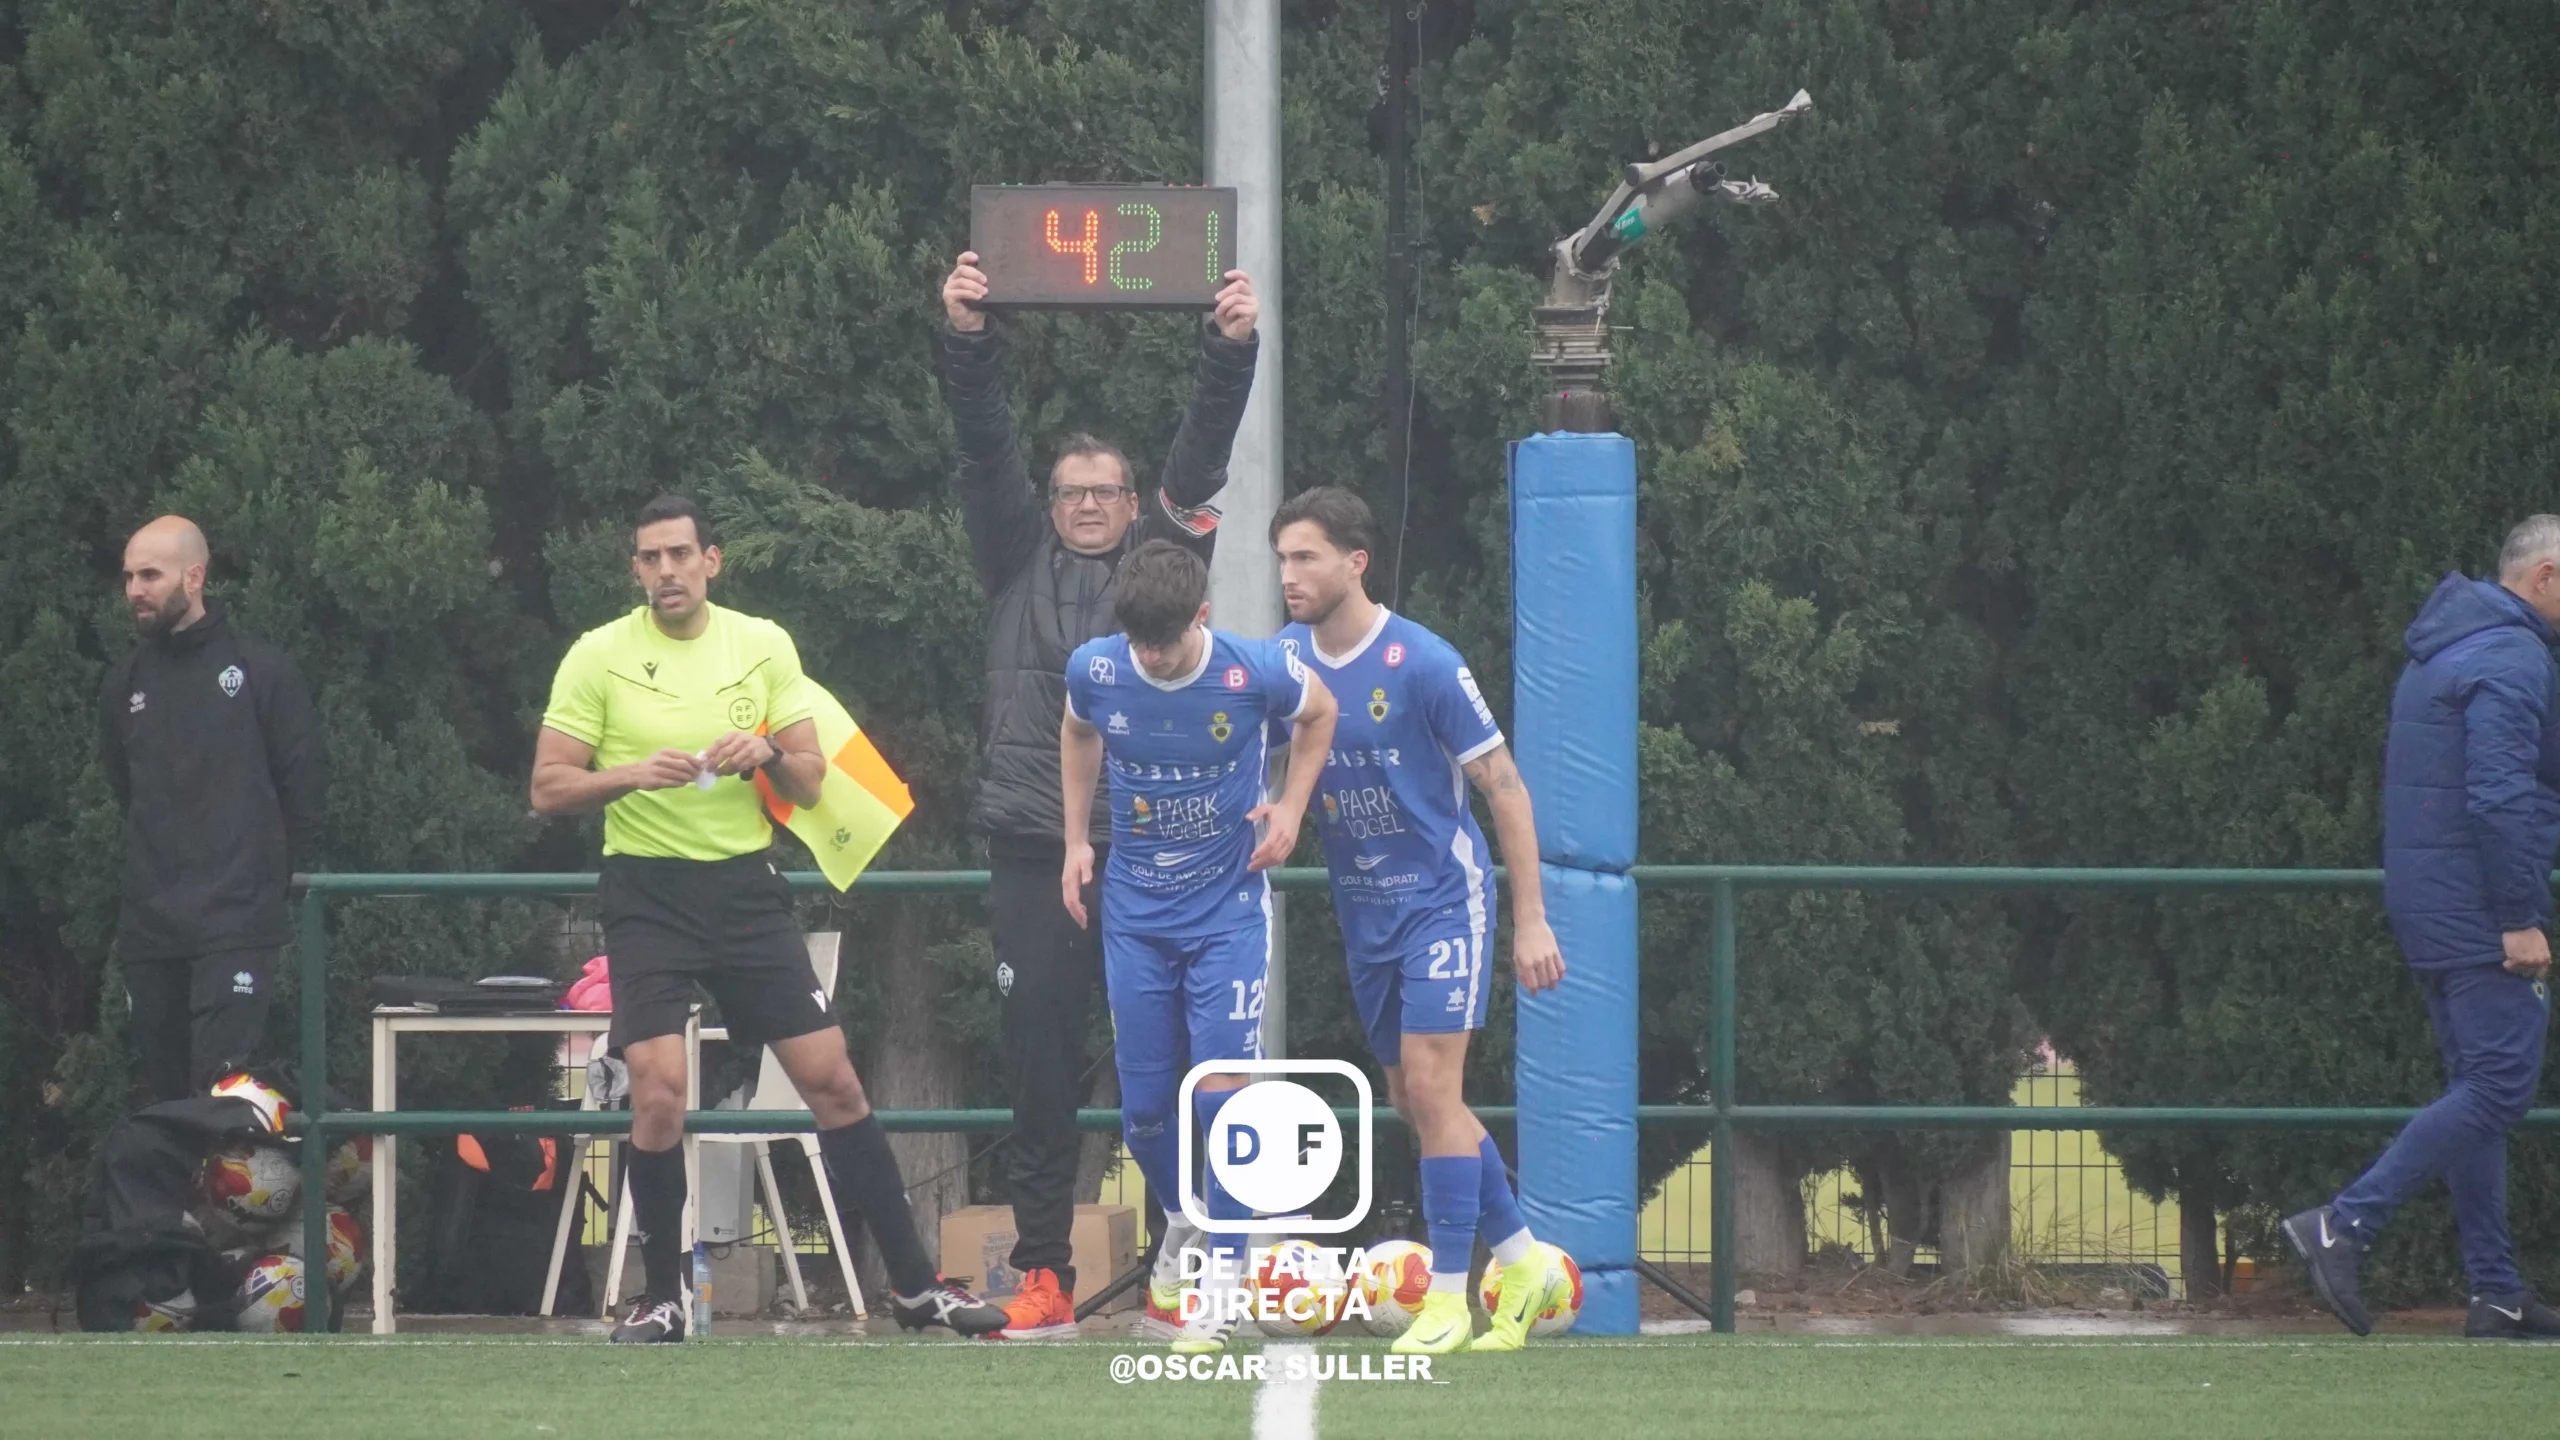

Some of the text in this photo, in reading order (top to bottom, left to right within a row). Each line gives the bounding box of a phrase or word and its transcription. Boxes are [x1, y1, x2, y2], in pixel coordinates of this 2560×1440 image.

[1383, 646, 1402, 663] B
[1229, 669, 1244, 687] B
[1156, 792, 1220, 821] PARK
[1340, 786, 1398, 817] PARK
[1158, 819, 1221, 840] VOGEL
[1346, 814, 1405, 839] VOGEL
[1428, 937, 1469, 980] 21
[1229, 978, 1263, 1020] 12
